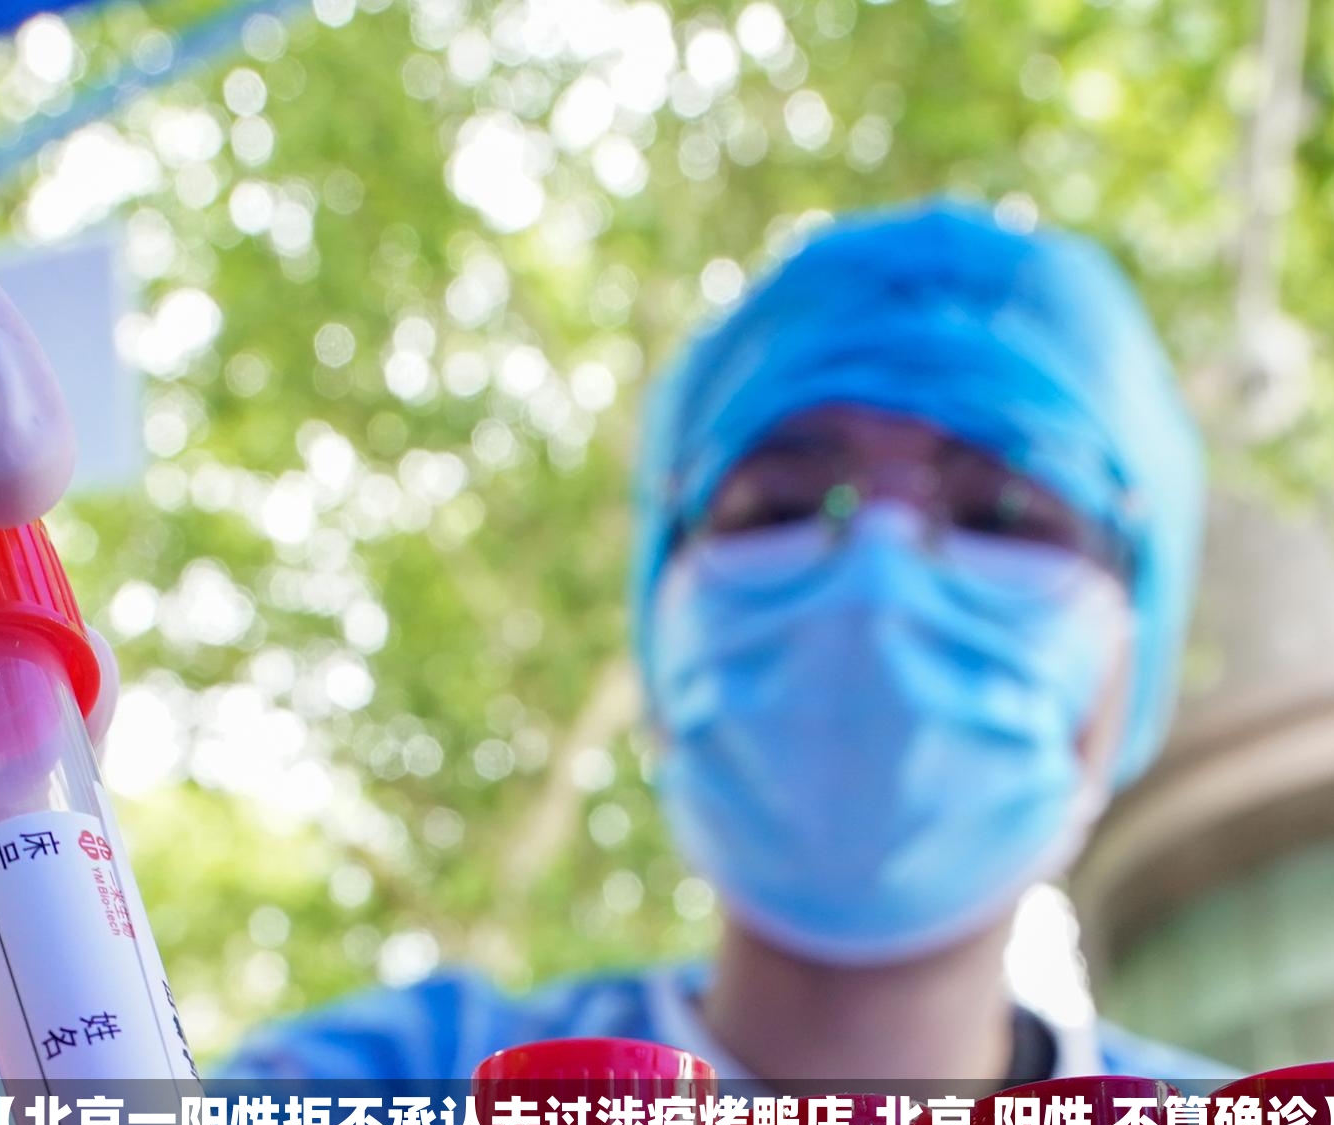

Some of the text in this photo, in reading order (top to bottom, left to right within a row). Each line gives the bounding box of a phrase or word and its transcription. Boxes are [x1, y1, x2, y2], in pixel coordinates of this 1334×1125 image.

[91, 866, 122, 937] YM Bio-tech
[41, 1011, 124, 1061] 姓名
